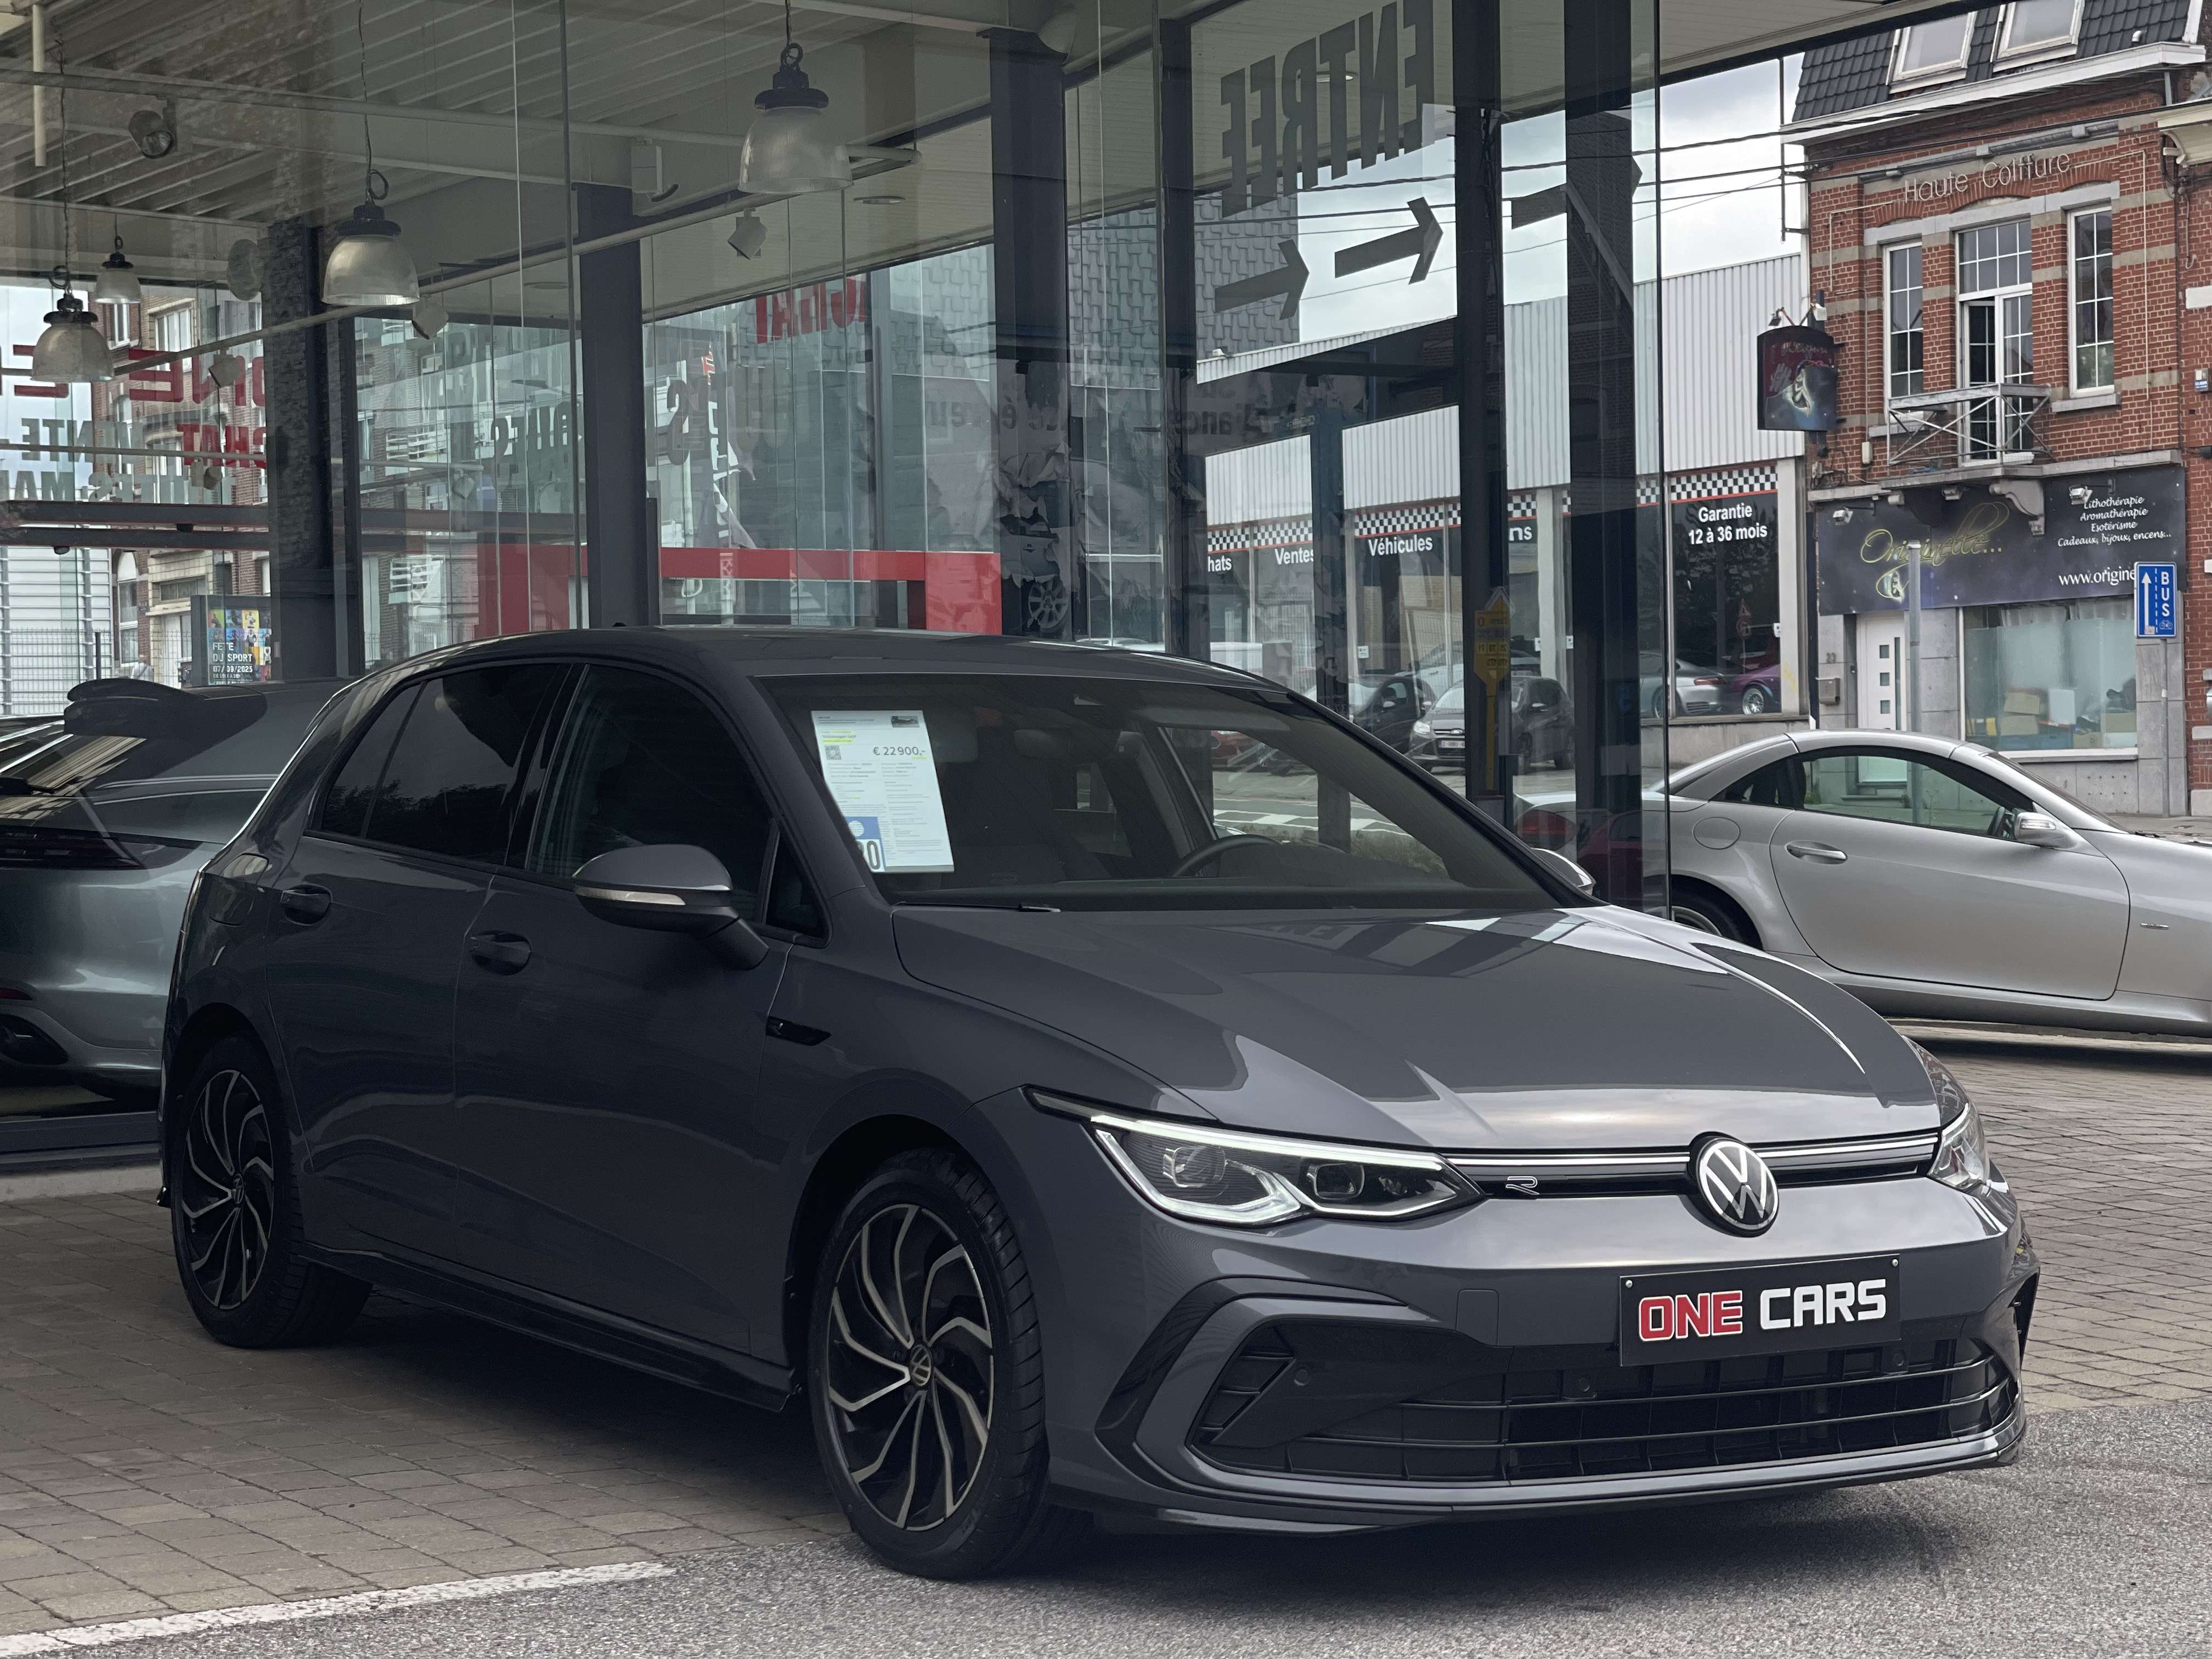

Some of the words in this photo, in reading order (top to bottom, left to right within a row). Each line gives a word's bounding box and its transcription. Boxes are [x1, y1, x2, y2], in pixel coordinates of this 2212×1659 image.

[1904, 171, 1968, 204] Haute
[2084, 495, 2145, 509] Lithothérapie
[1698, 503, 1753, 522] Garantie
[2080, 507, 2149, 522] Aromathérapie
[1688, 529, 1703, 545] 12
[1706, 527, 1714, 543] à
[1717, 525, 1733, 542] 36
[1735, 522, 1768, 540] mois
[2091, 520, 2138, 532] Esotérisme
[1368, 534, 1434, 557] Véhicules
[2058, 536, 2099, 547] Cadeaux,
[2102, 533, 2131, 545] bijoux,
[2160, 571, 2170, 617] BUS
[212, 653, 224, 662] DU
[227, 653, 253, 662] SPORT
[1505, 1175, 1540, 1195] R
[1638, 1290, 1743, 1342] ONE
[1760, 1278, 1887, 1331] CARS
